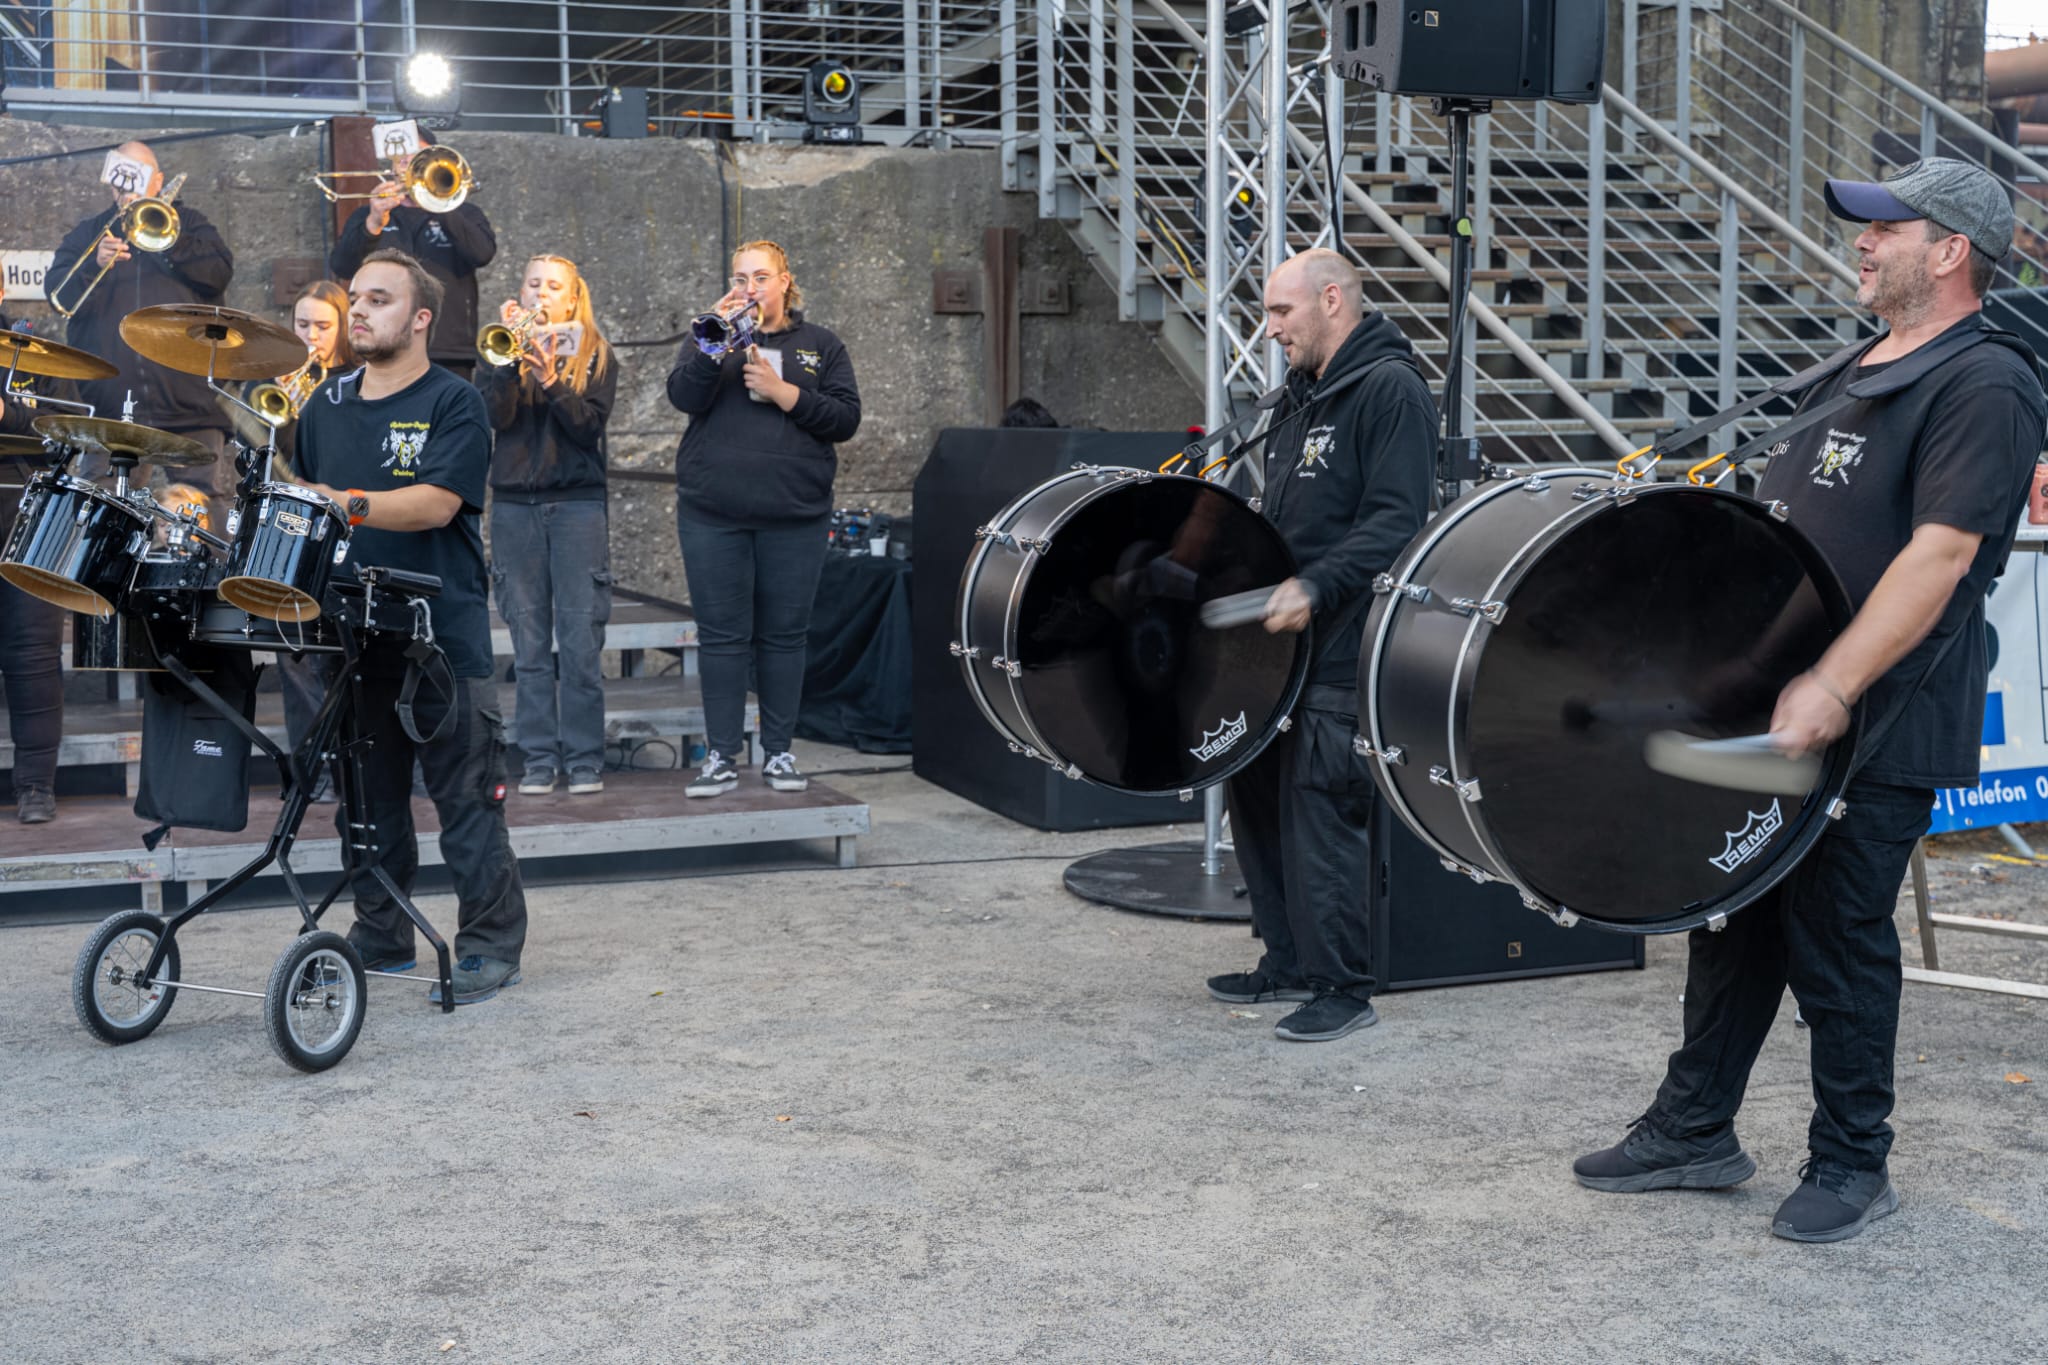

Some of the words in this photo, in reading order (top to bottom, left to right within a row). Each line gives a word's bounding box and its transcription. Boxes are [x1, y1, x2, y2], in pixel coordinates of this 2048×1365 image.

[1201, 724, 1243, 757] REMO
[1956, 779, 2027, 808] Telefon
[1725, 815, 1776, 866] REMO
